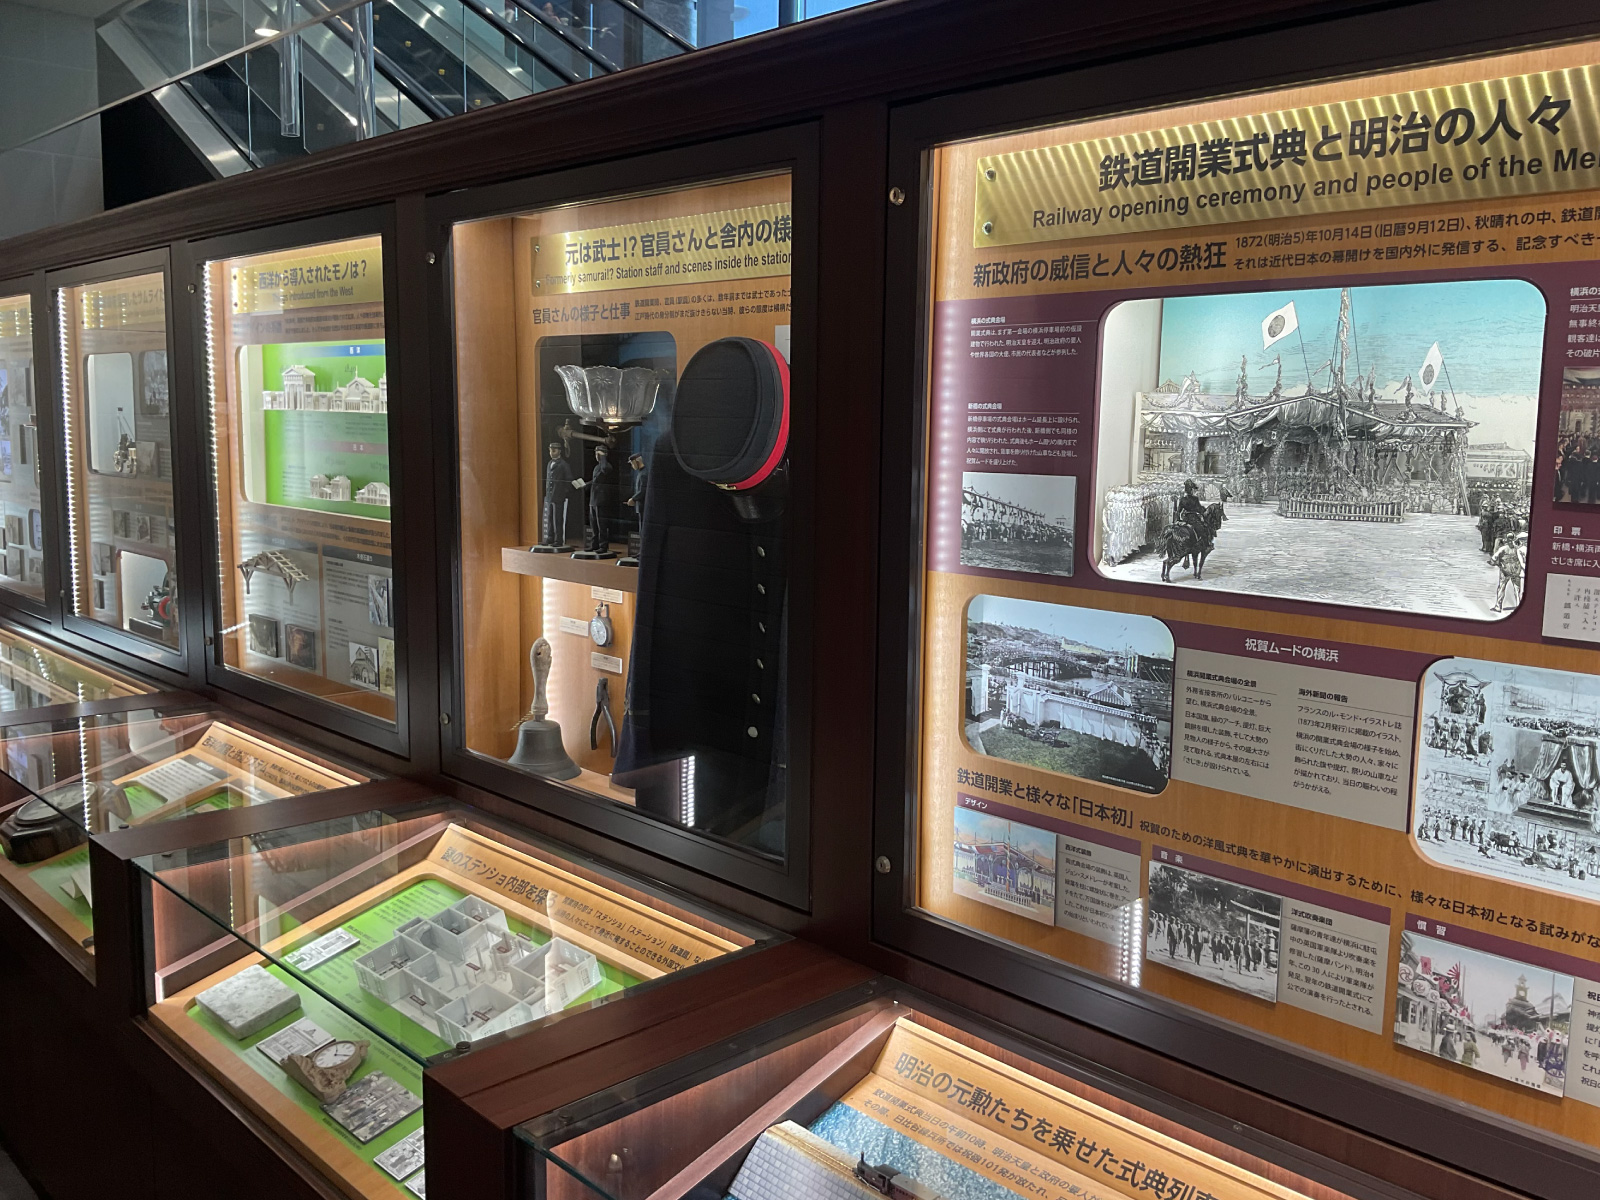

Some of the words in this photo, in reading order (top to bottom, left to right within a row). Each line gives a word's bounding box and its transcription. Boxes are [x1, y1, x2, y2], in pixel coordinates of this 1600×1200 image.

[1098, 94, 1572, 193] 鉄道開業式典と明治の人々
[1033, 205, 1103, 228] Railway
[1108, 194, 1189, 220] opening
[1196, 182, 1306, 209] ceremony
[1313, 172, 1358, 197] and
[1366, 163, 1453, 196] people
[1462, 157, 1493, 181] of
[1497, 153, 1543, 179] the
[1553, 147, 1600, 173] Me
[973, 241, 1227, 288] 新政府の威信と人々の熱狂
[1233, 232, 1600, 270] それは近代日本の幕開けを国内外に発信する、記念すべき
[616, 264, 643, 280] Station
[645, 261, 663, 277] staff
[664, 262, 680, 274] and
[682, 260, 712, 274] scenes
[715, 255, 742, 270] inside
[744, 253, 759, 268] the
[317, 289, 329, 299] from
[329, 287, 338, 297] the
[340, 285, 354, 296] West
[532, 302, 630, 325] 官員さんの様子と仕事
[1245, 637, 1339, 663] 祝賀ムードの横浜
[1298, 687, 1348, 703] 海外新聞の報告
[957, 767, 1133, 829] 鉄道開業と様々な「日本初」
[964, 797, 988, 809] デザイン
